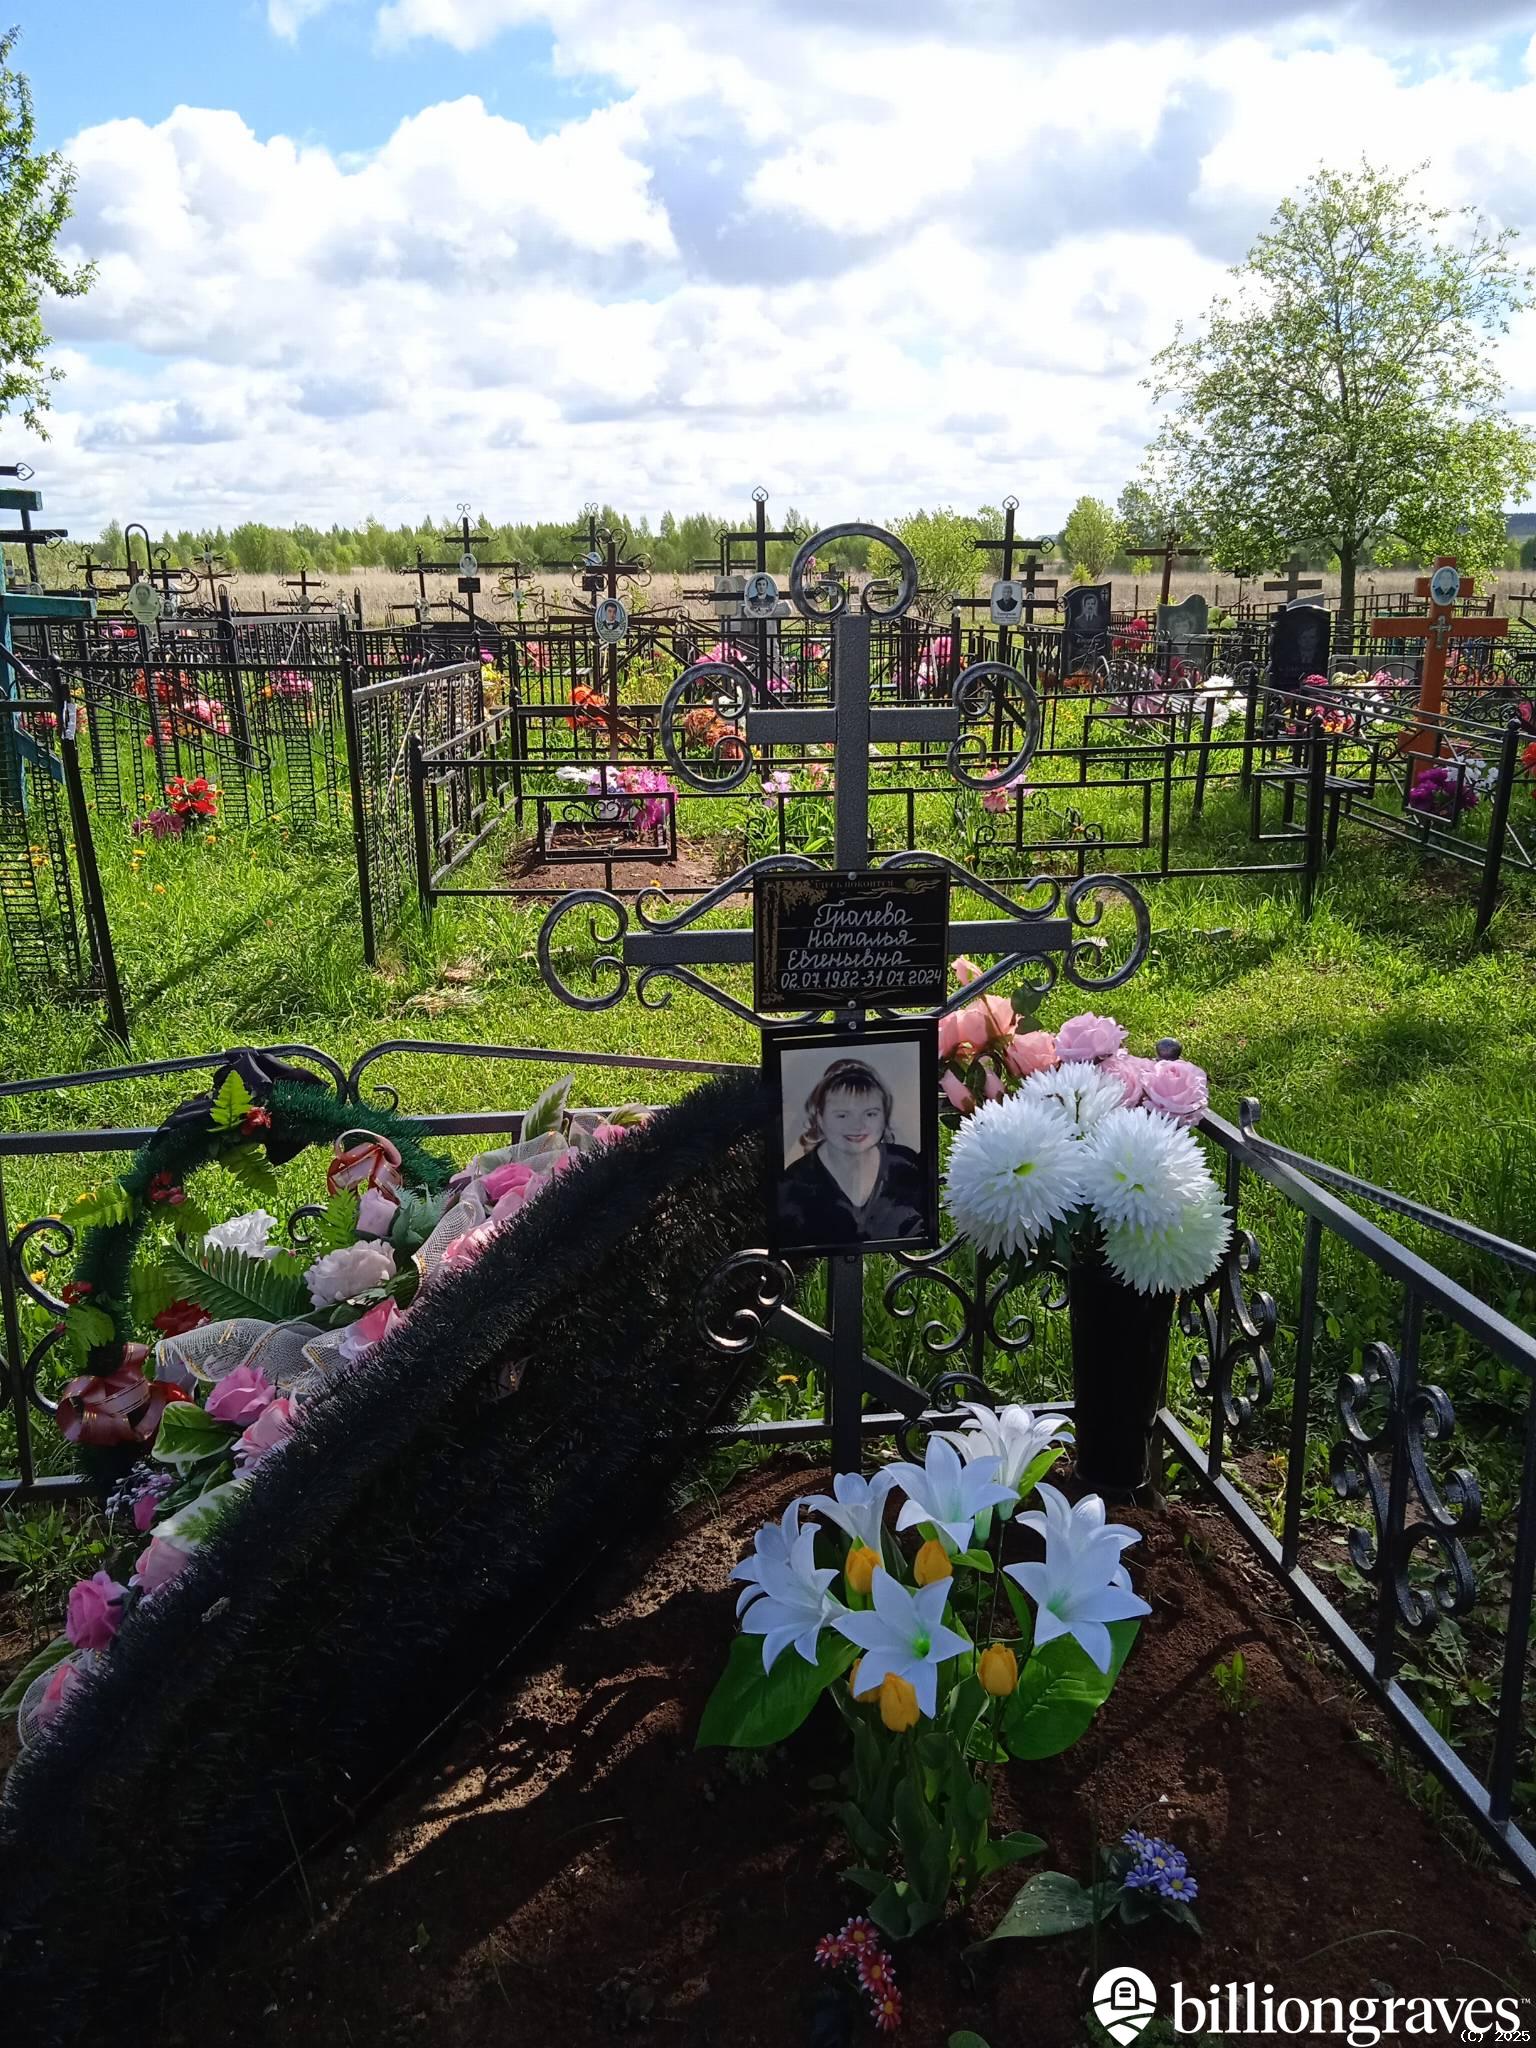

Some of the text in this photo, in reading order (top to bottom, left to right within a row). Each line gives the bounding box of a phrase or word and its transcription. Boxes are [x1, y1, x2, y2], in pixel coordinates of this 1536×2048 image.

[814, 901, 913, 932] Грачева
[808, 929, 917, 948] Наталья
[788, 949, 911, 970] Евгеньевна
